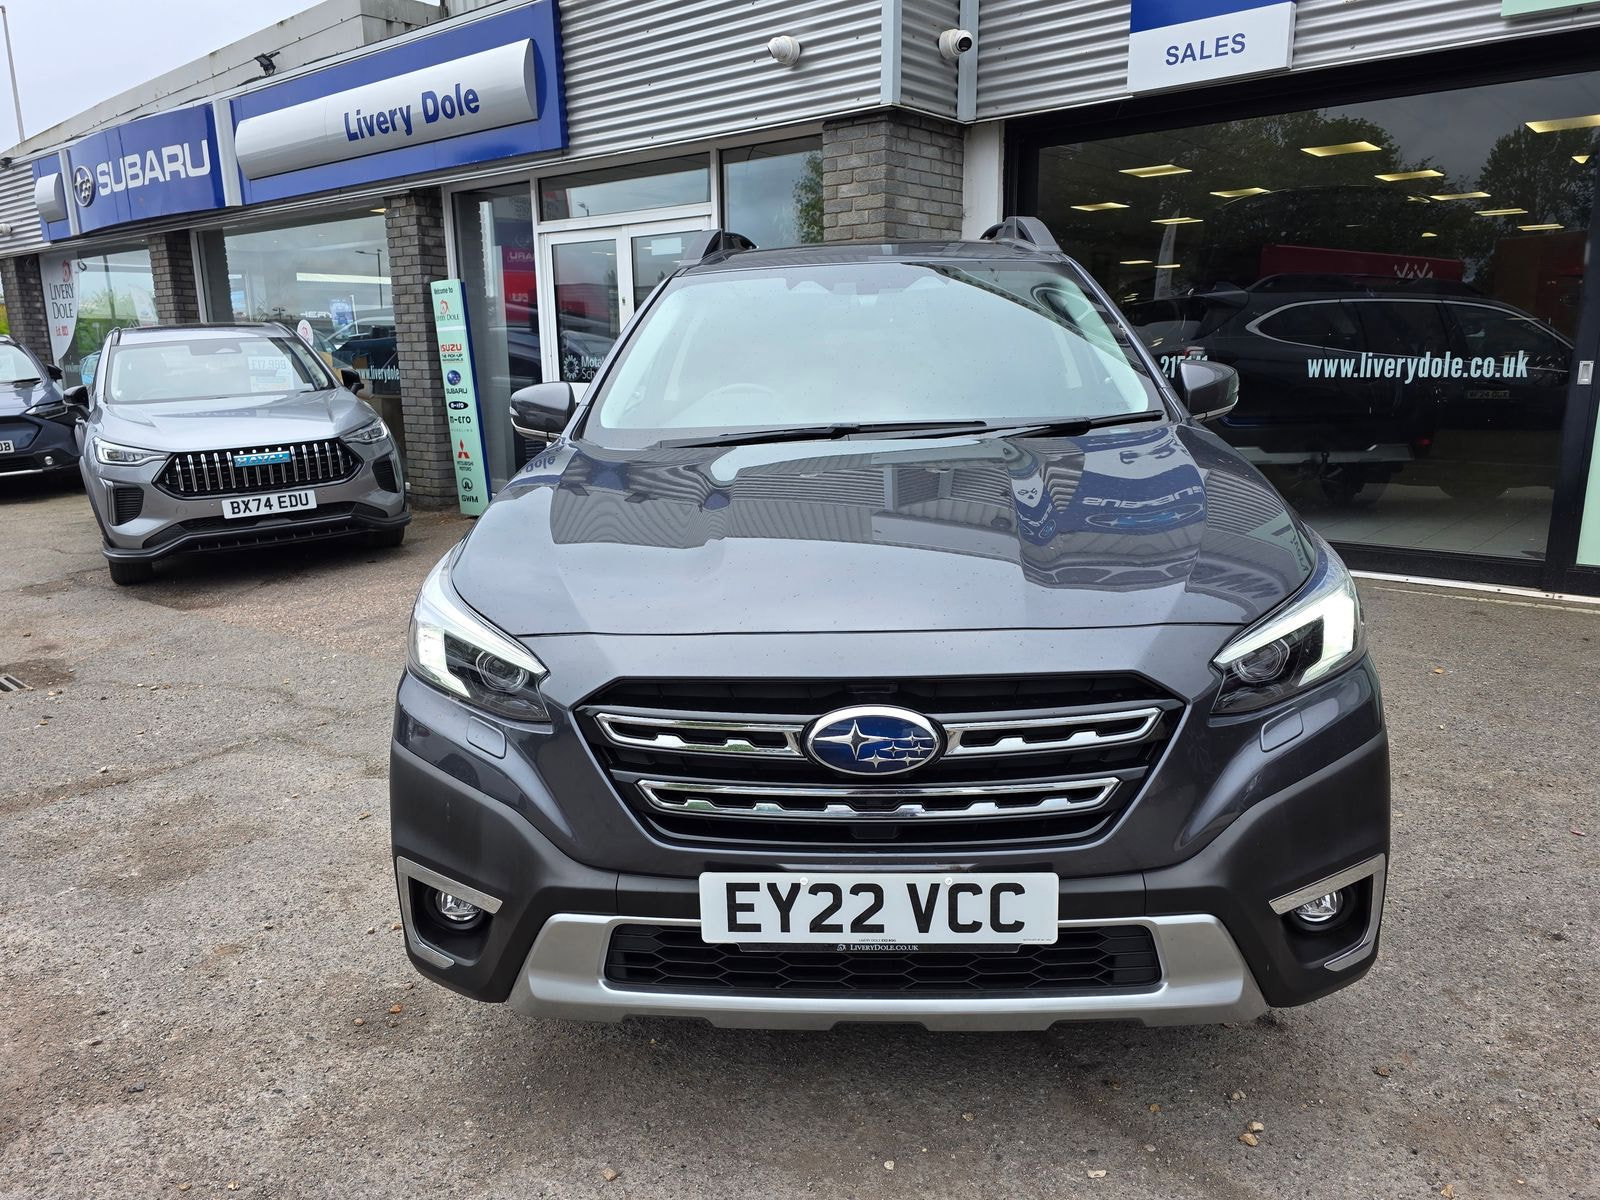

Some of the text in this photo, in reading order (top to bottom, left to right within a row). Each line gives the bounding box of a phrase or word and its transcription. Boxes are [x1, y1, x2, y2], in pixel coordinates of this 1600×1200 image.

[1165, 33, 1246, 66] SALES
[343, 83, 480, 142] Livery Dole
[96, 139, 211, 196] SUBARU
[49, 283, 75, 300] LIVERY
[52, 302, 74, 319] DOLE
[441, 343, 462, 352] ISUZU
[1307, 350, 1530, 385] www.liverydole.co.uk
[230, 492, 309, 515] BX74 EDU
[461, 495, 479, 503] GWM
[725, 882, 1026, 933] EY22 VCC
